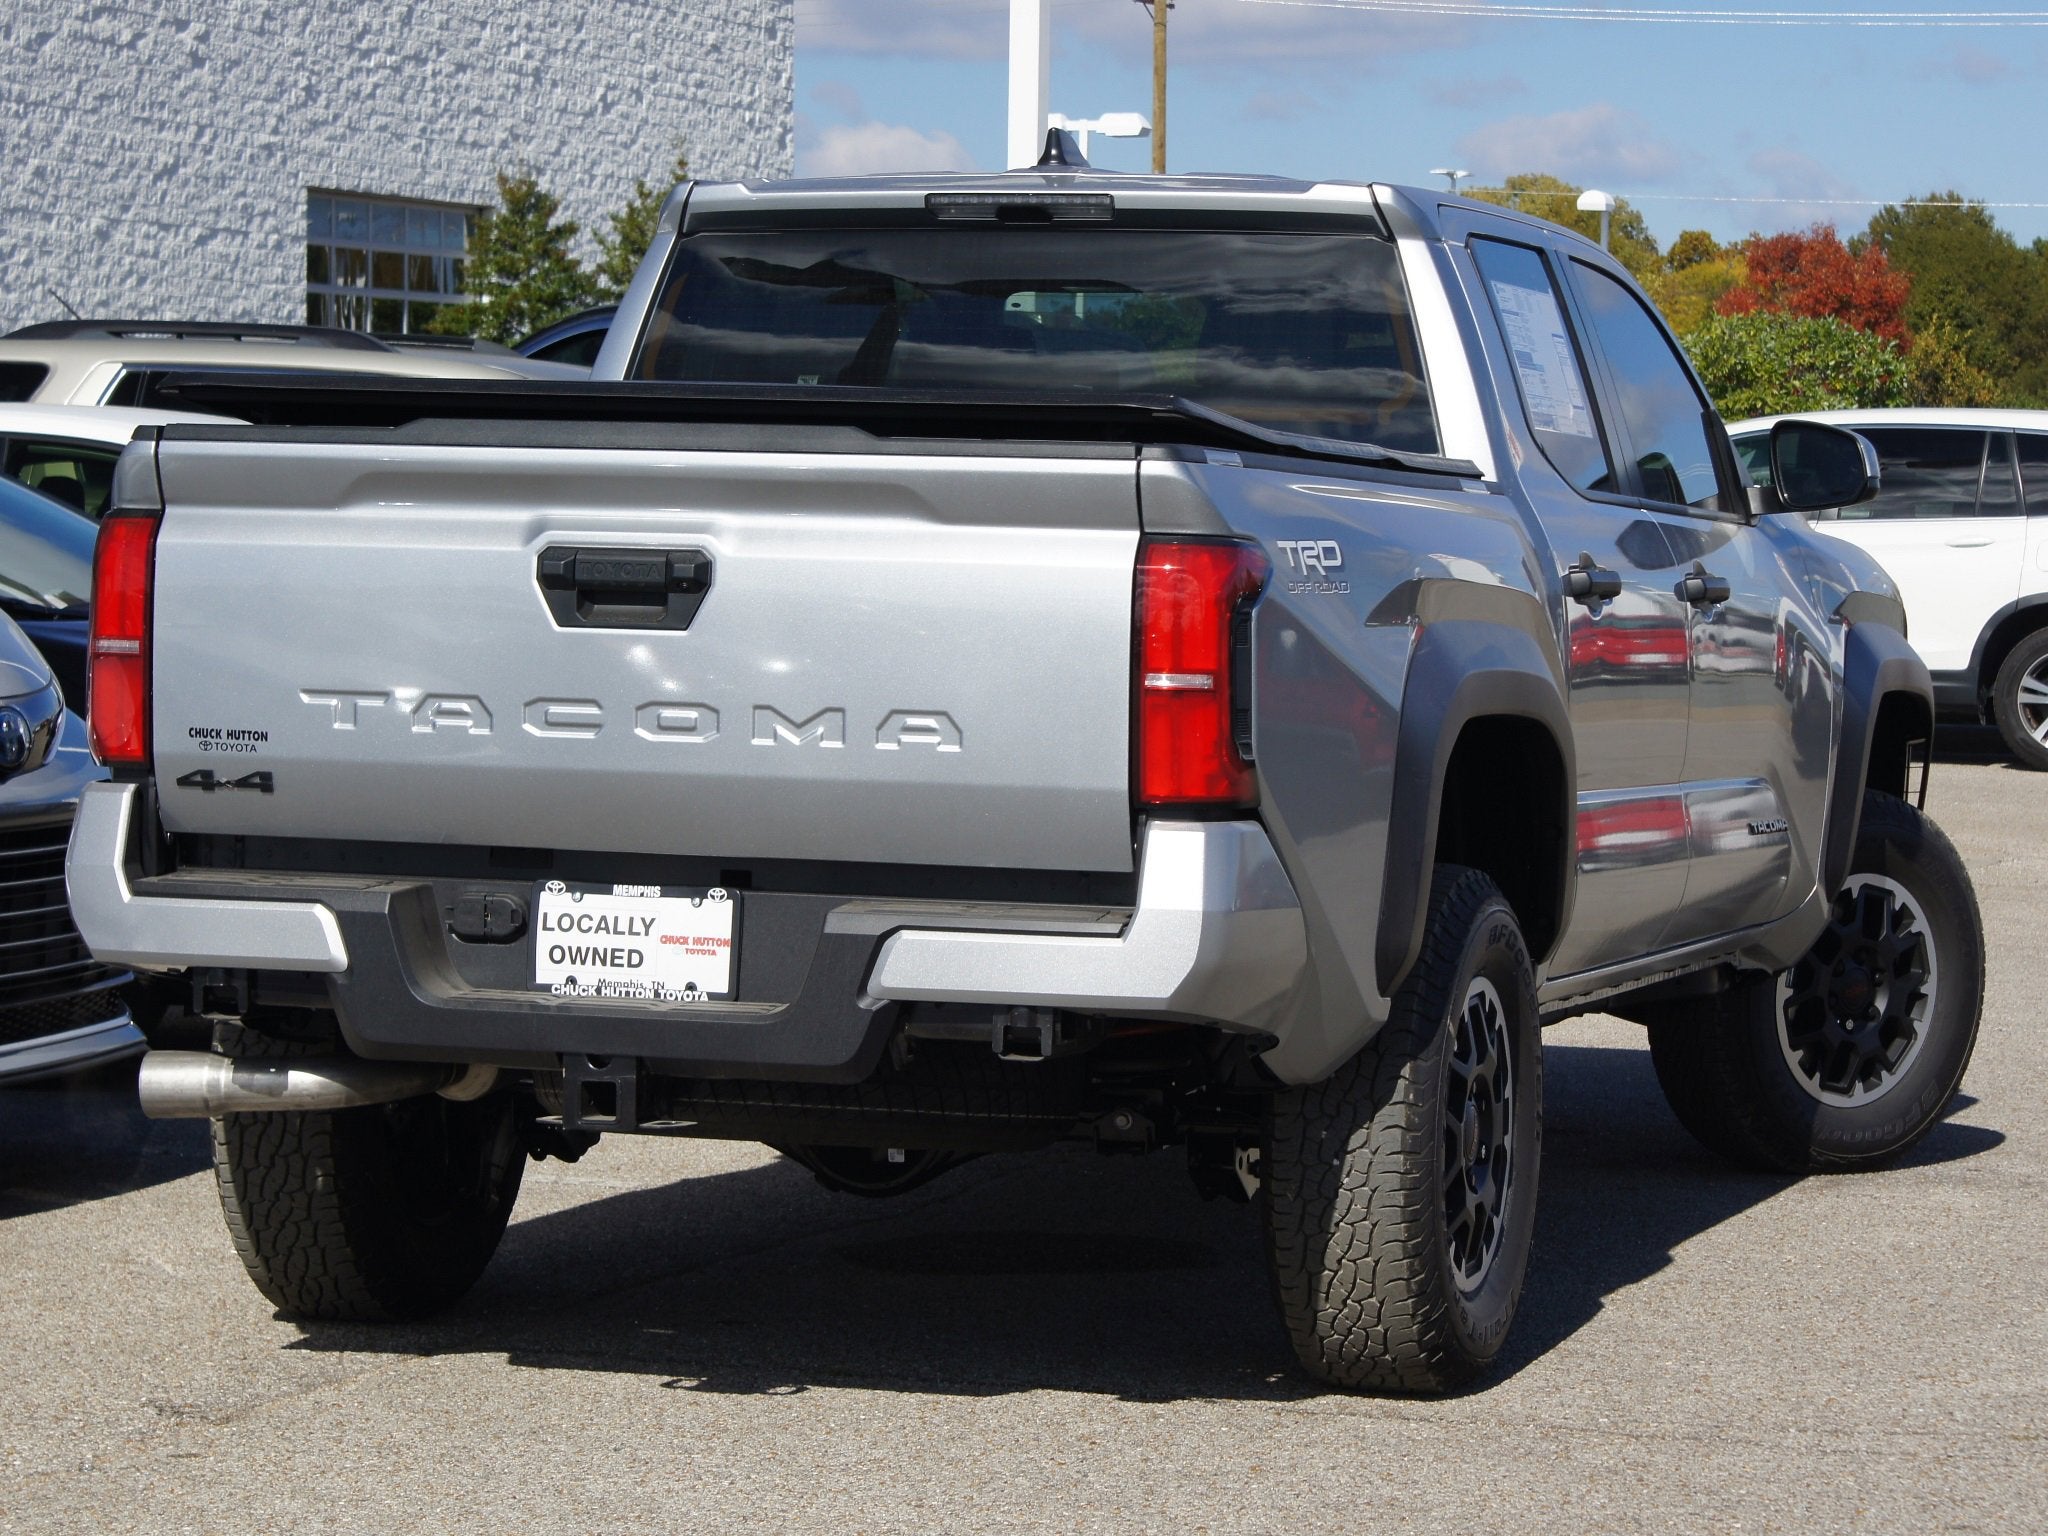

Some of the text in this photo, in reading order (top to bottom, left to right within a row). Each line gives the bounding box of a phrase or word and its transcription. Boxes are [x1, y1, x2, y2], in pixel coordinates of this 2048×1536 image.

[1276, 540, 1342, 575] TRD
[579, 561, 662, 579] TOYOTA
[1288, 582, 1351, 594] OFF ROAD
[298, 687, 964, 753] TACOMA
[188, 727, 269, 743] CHUCK HUTTON
[214, 742, 258, 753] TOYOTA
[1752, 819, 1788, 834] TACOMA
[612, 884, 662, 898] MEMPHIS
[542, 912, 656, 936] LOCALLY
[659, 934, 733, 948] CHUCK HUTTON
[548, 944, 645, 969] OWNED
[684, 947, 718, 957] TOYOTA
[550, 983, 709, 1001] CHUCK HUTTON TOYOTA
[651, 980, 666, 990] TN
